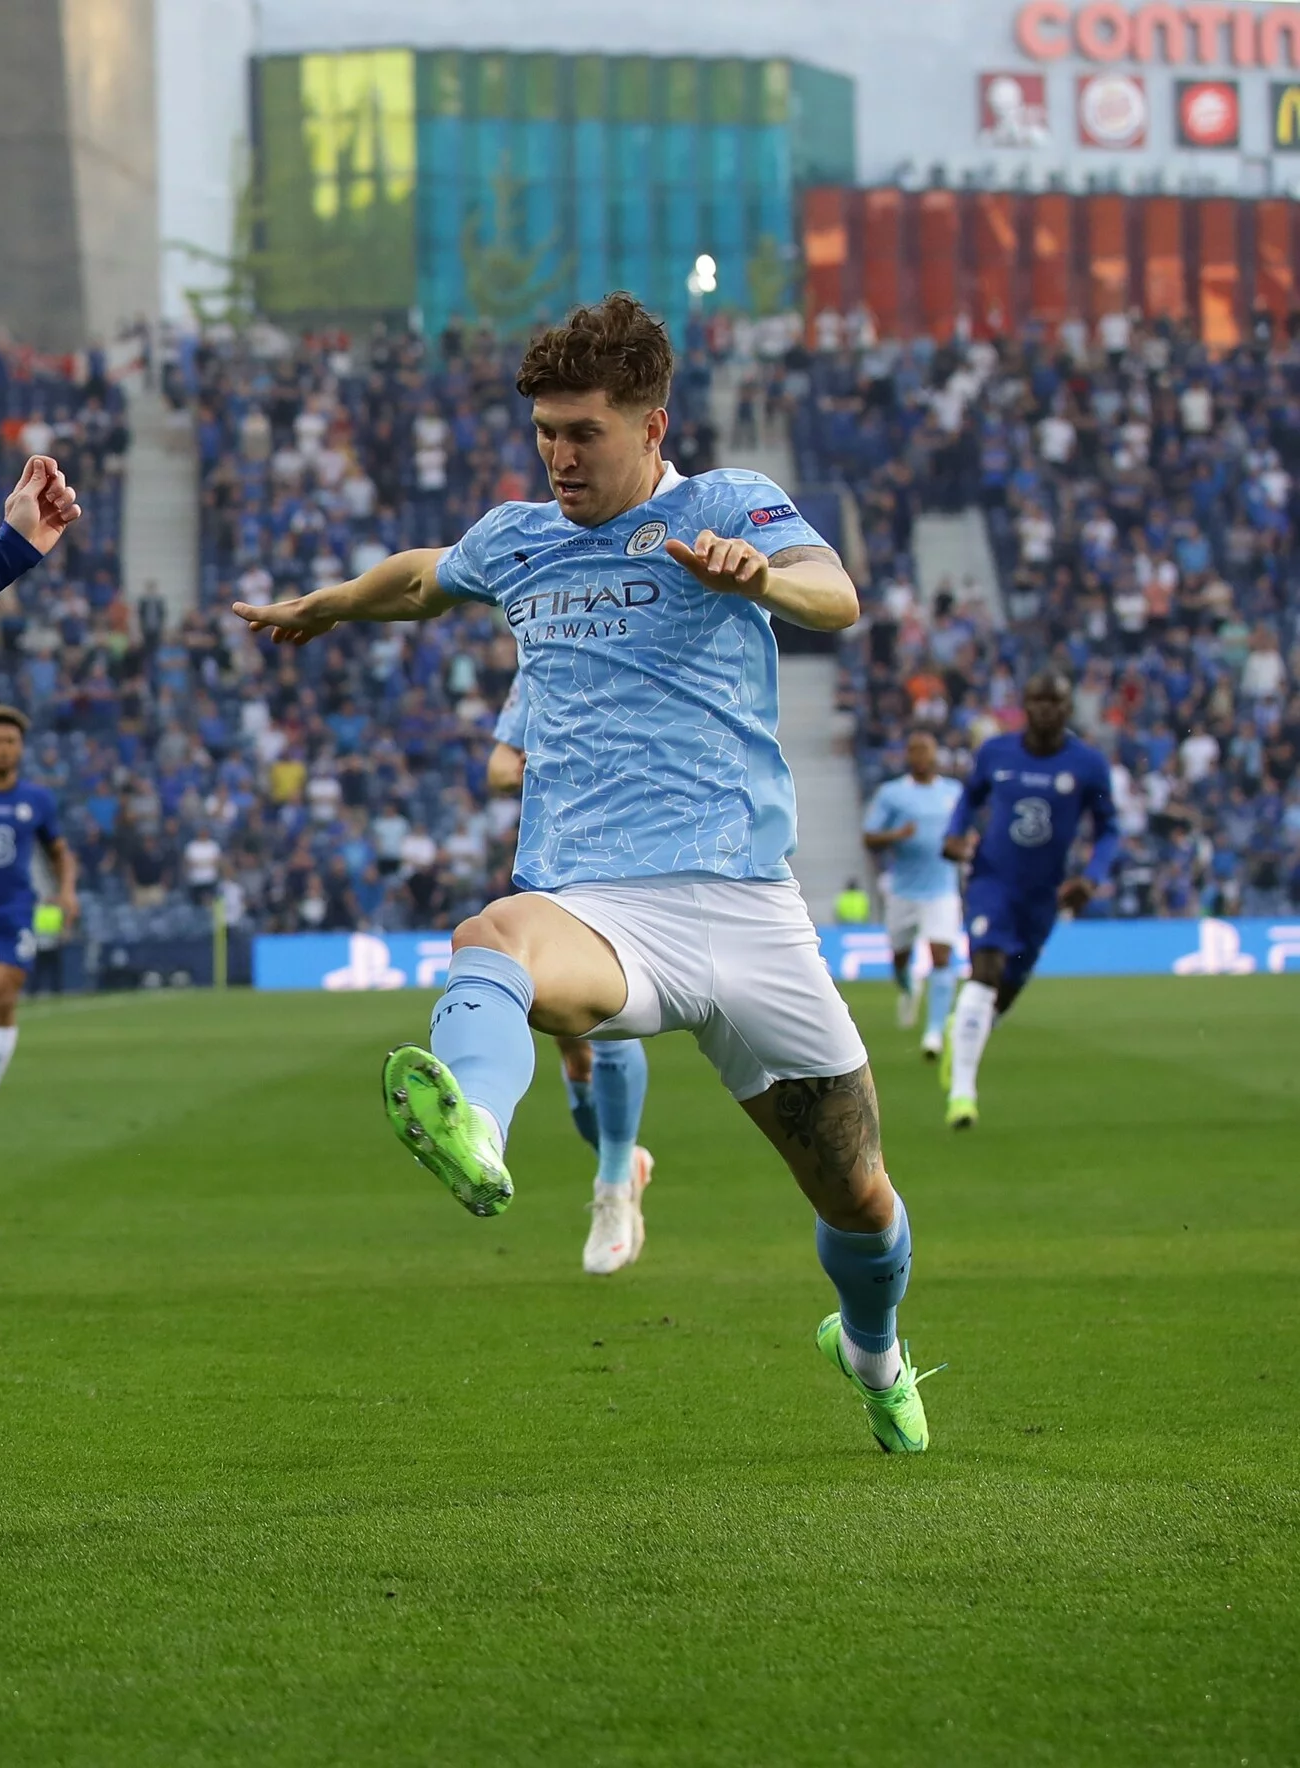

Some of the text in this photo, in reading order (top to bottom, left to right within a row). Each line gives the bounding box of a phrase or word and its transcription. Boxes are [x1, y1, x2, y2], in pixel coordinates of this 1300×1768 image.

[568, 539, 594, 547] PORTO
[596, 538, 613, 546] 2021
[506, 580, 660, 627] ETIHAD
[523, 618, 627, 647] AIRWAYS
[1008, 796, 1053, 848] 3
